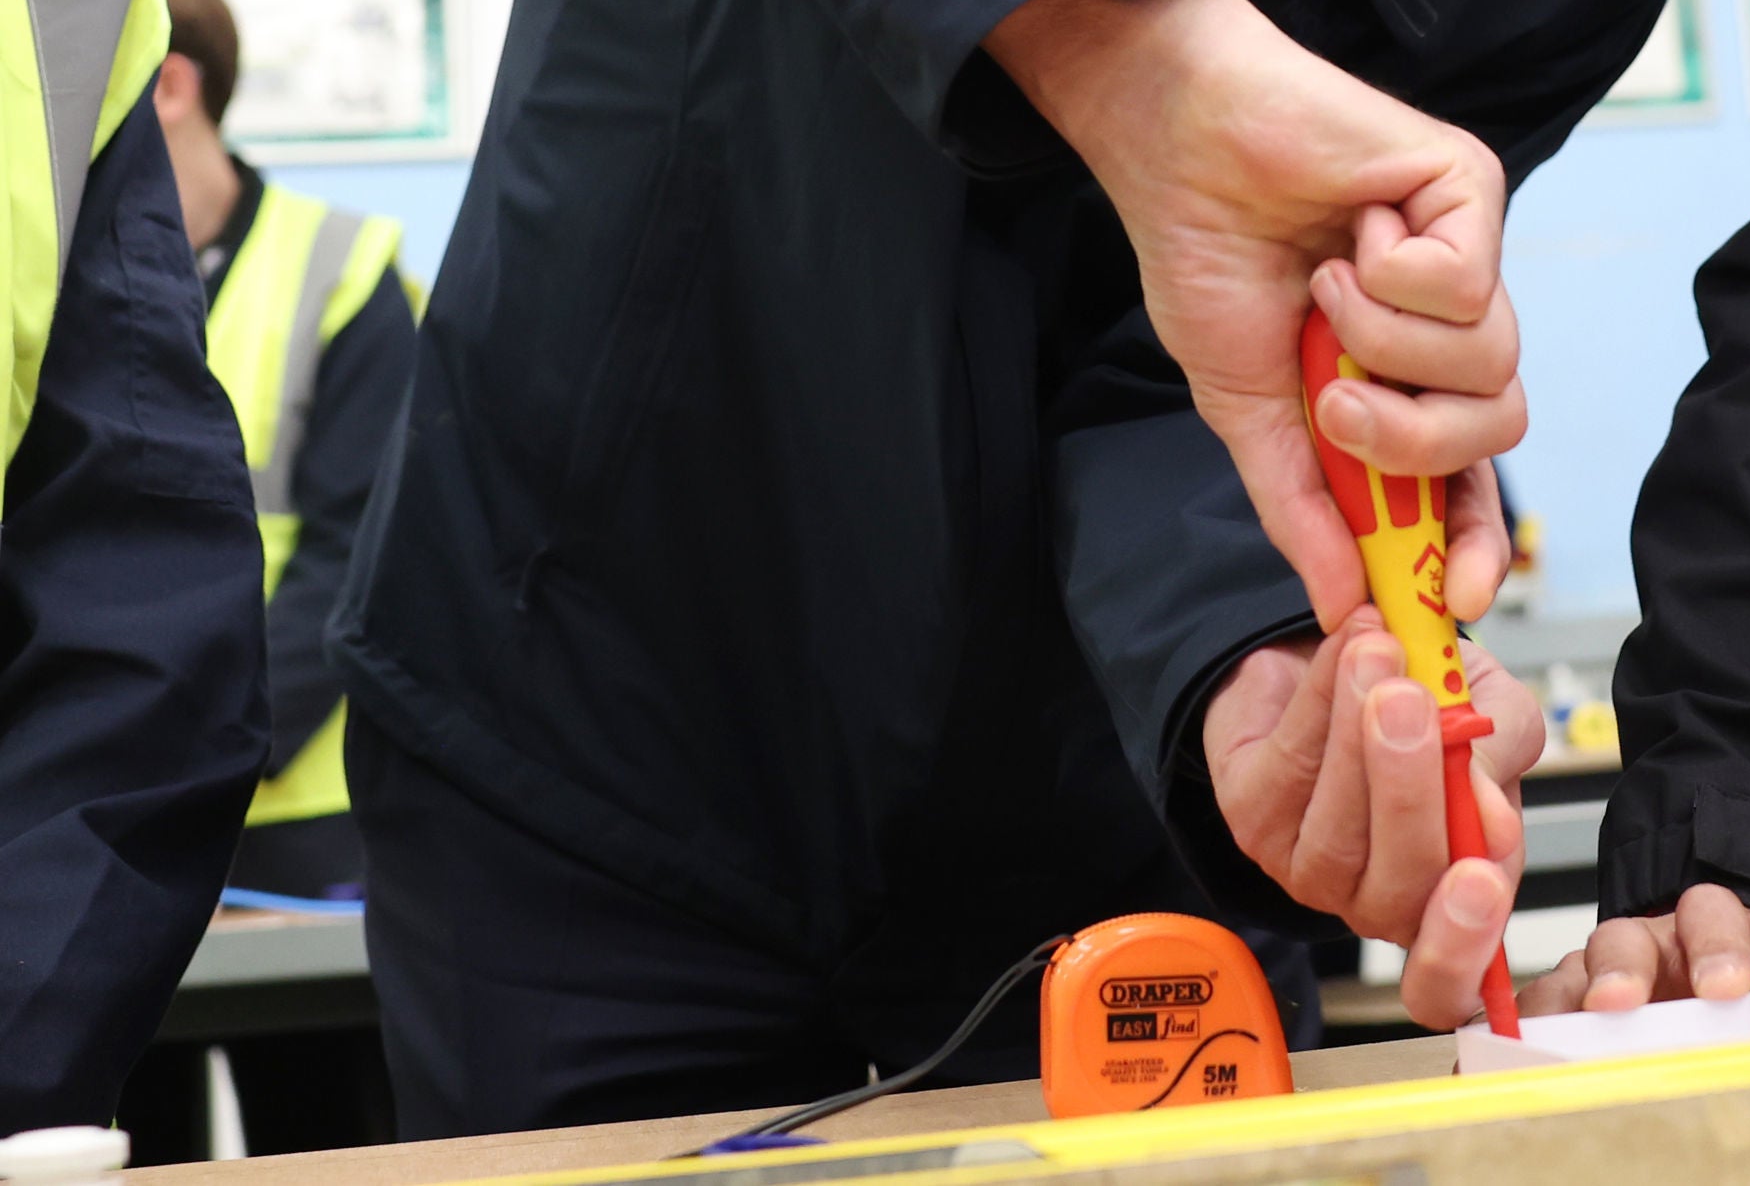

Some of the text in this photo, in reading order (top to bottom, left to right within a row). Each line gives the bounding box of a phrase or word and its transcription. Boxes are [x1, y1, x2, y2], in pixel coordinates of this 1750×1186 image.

[1110, 982, 1205, 1003] DRAPER
[1112, 1013, 1196, 1040] EASY find
[1204, 1064, 1238, 1083] 5M
[1203, 1085, 1238, 1096] 16FT
